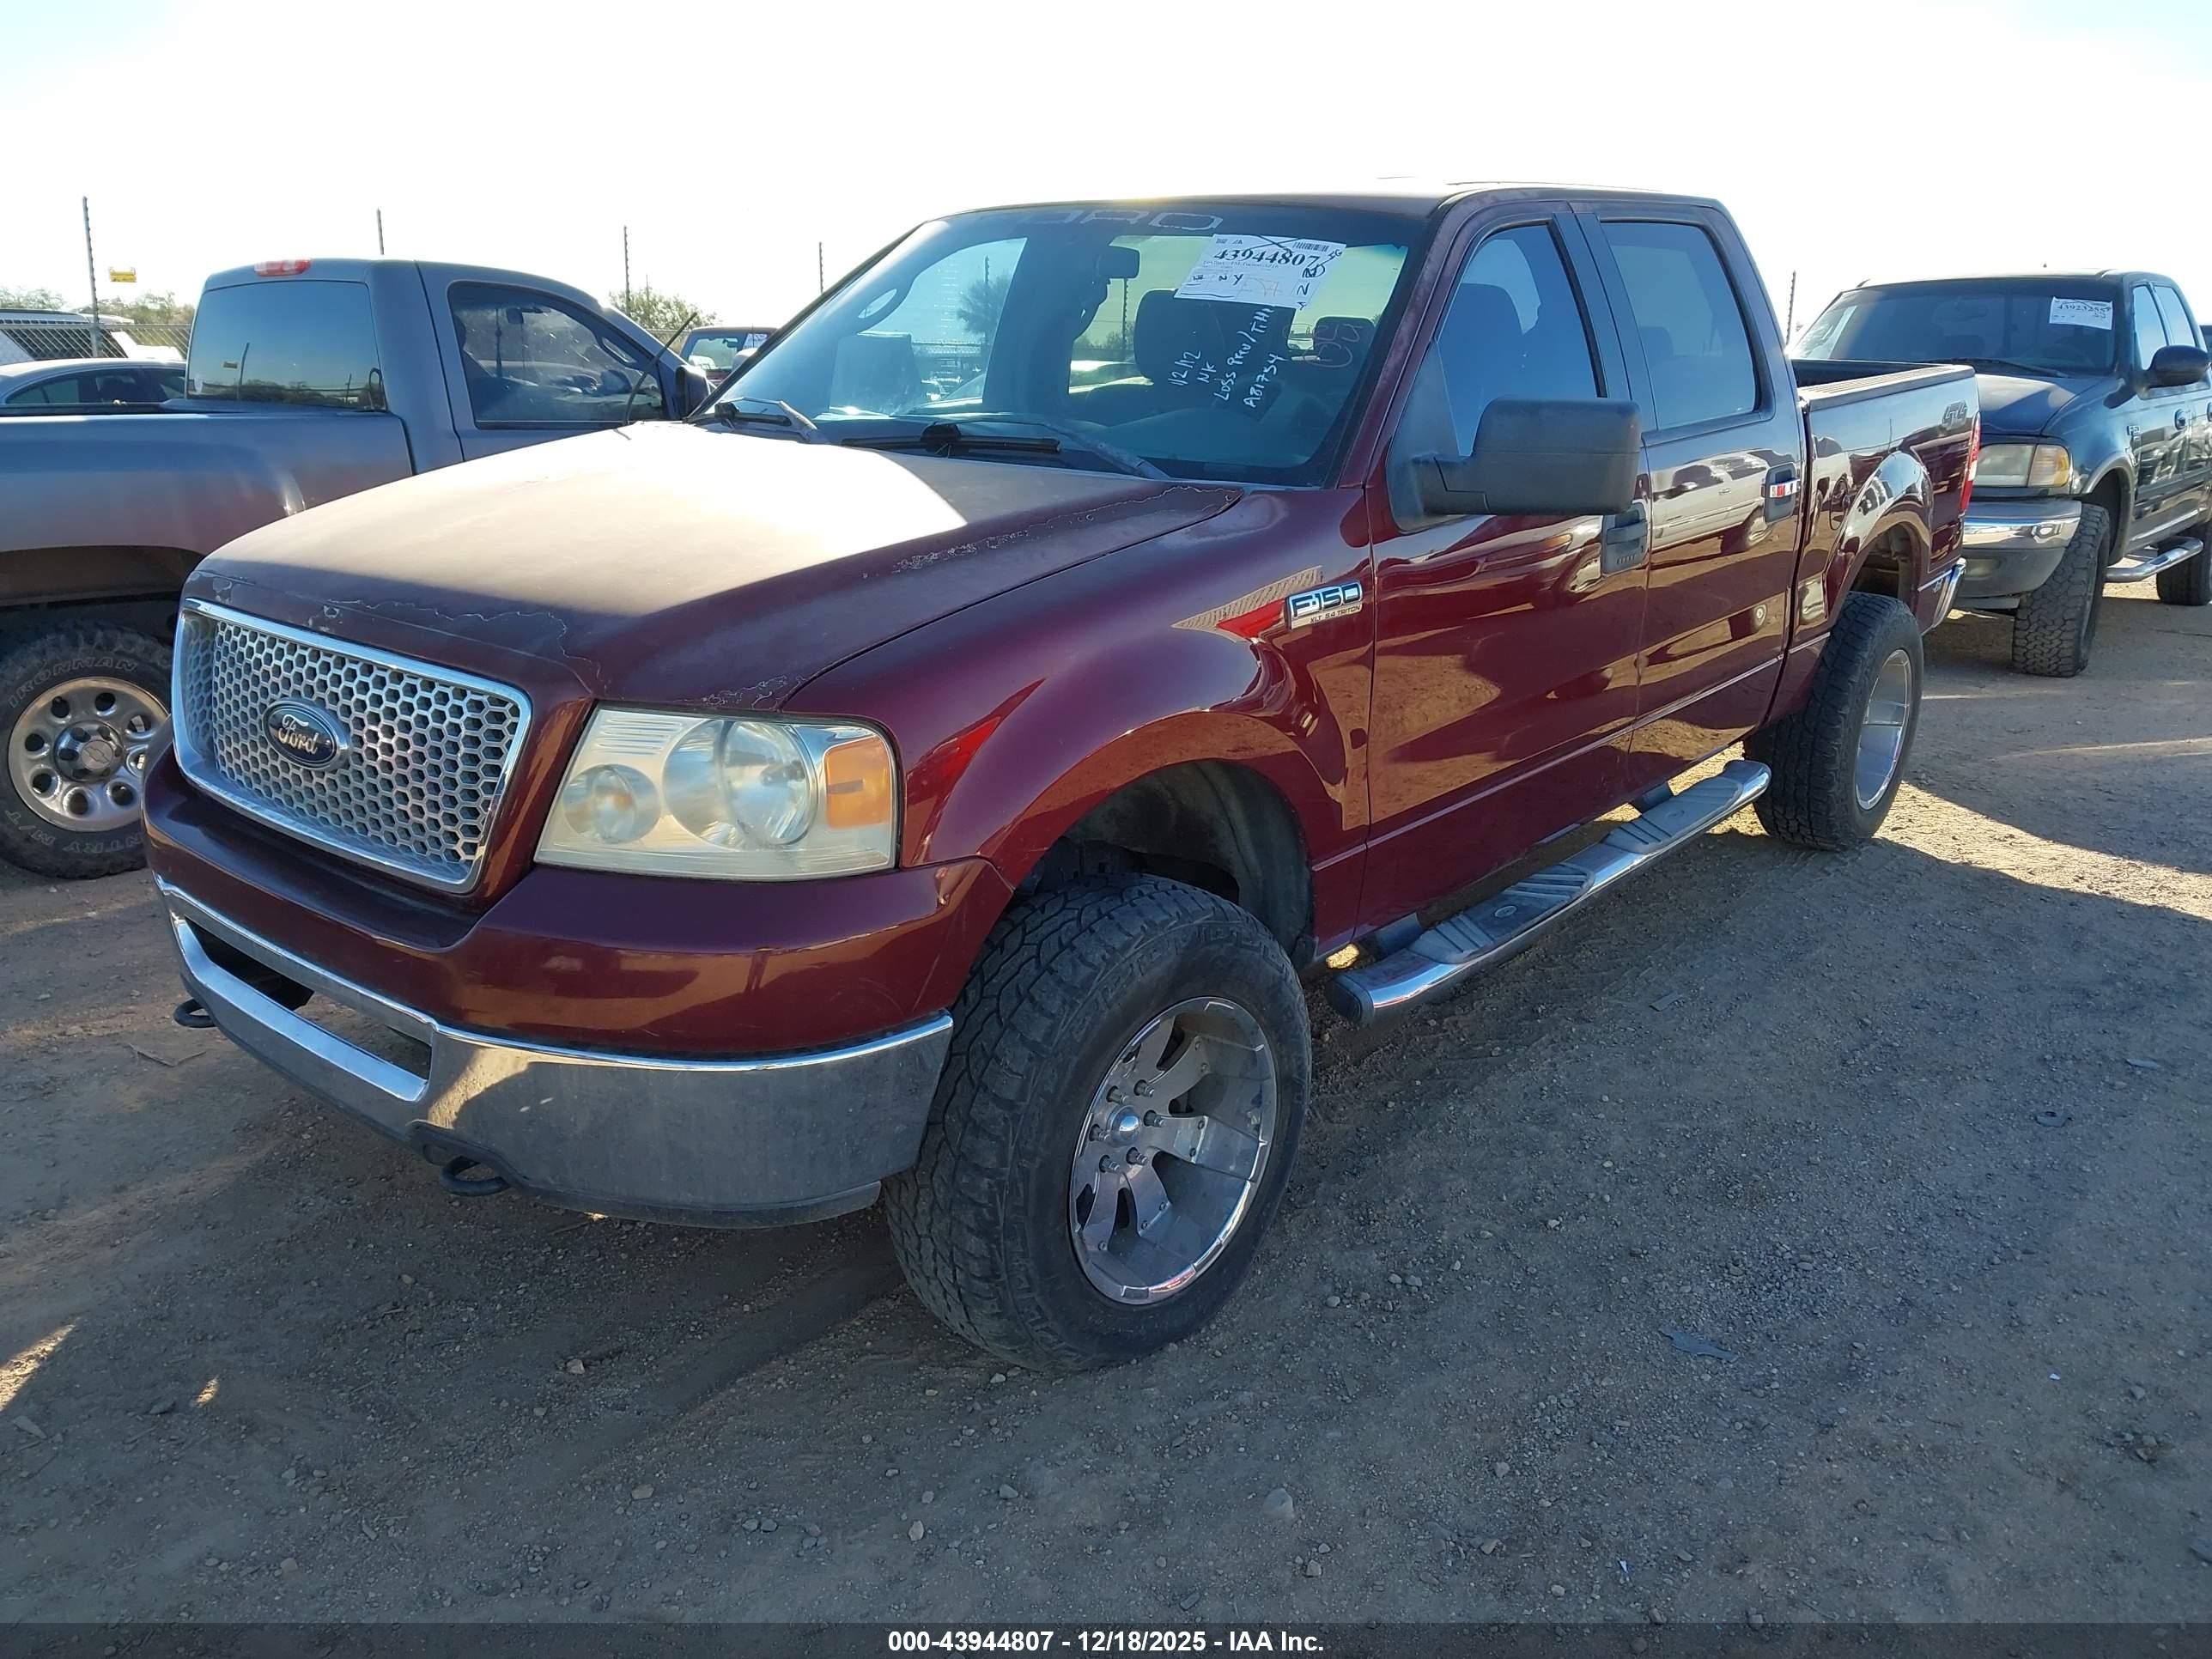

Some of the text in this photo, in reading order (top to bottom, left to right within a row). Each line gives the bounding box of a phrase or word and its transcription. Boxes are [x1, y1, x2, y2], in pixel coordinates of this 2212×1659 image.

[1213, 248, 1322, 270] 43944807
[1196, 361, 1217, 384] NK
[1337, 604, 1361, 616] TRITON
[8, 656, 138, 709] IRONMAN
[277, 714, 319, 755] Ford
